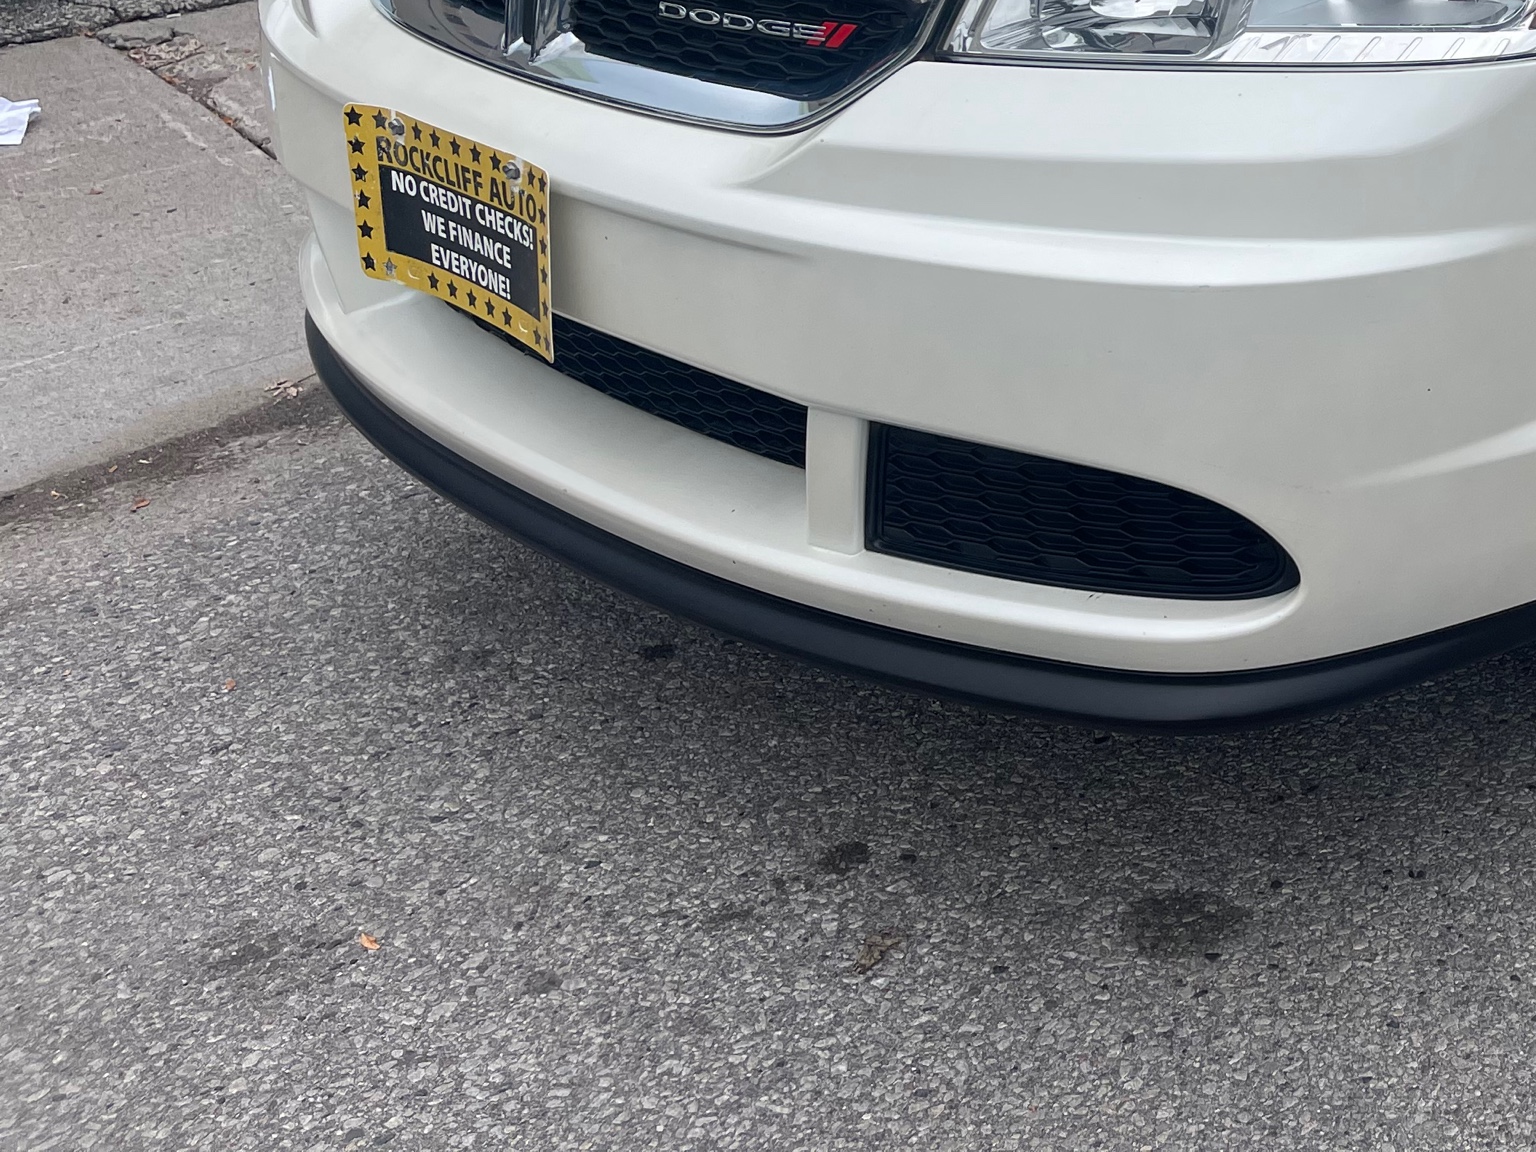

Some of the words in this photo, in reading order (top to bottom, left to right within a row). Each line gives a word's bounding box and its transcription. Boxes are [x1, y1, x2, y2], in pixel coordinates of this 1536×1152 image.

[658, 0, 827, 42] DODGE
[375, 135, 483, 196] ROCKCLIFF
[489, 176, 537, 223] AUTO
[390, 169, 417, 197] NO
[419, 180, 473, 220] CREDIT
[475, 203, 534, 250] CHECKS!
[421, 209, 447, 238] WE
[448, 219, 512, 269] FINANCE
[430, 242, 511, 300] EVERYONE!
